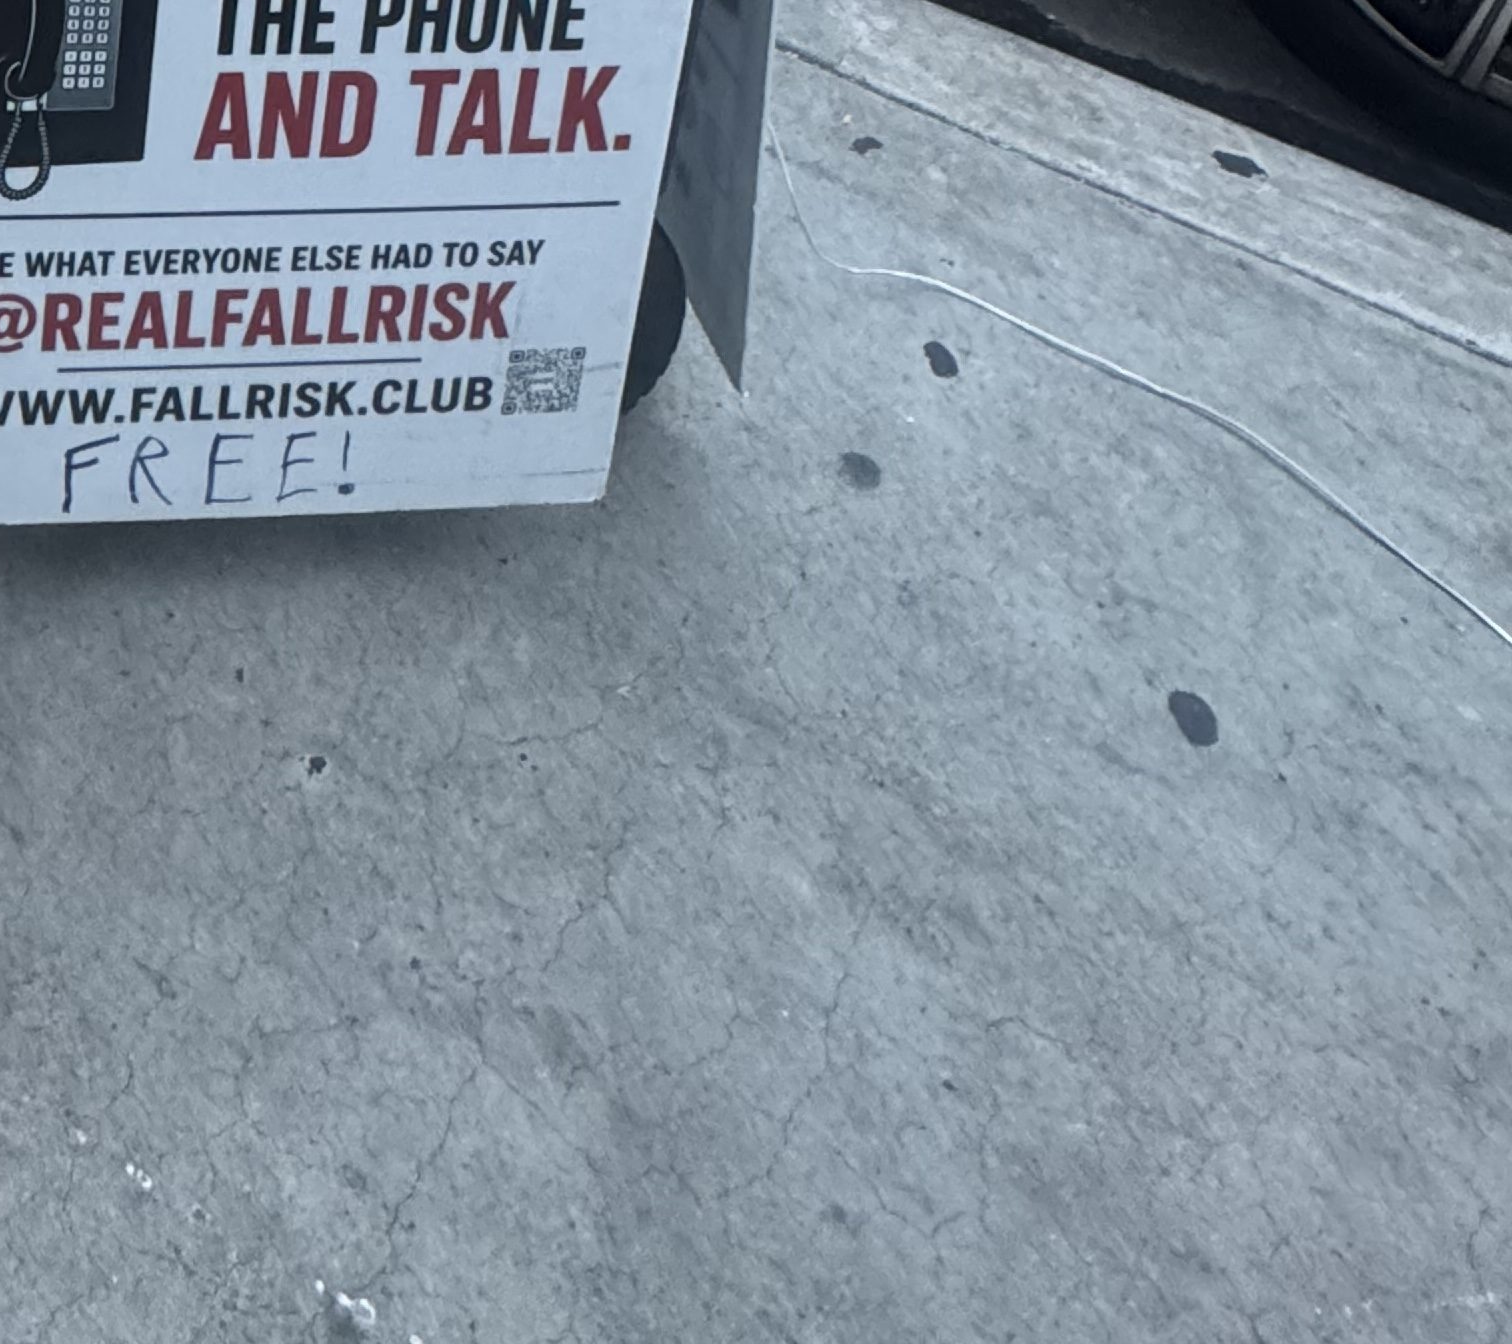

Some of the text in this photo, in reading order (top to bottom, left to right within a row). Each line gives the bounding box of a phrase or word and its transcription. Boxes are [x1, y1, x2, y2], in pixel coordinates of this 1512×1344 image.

[193, 65, 632, 160] AND TALK.
[25, 250, 116, 277] WHAT
[123, 247, 282, 276] EVERYONE
[290, 244, 363, 273] ELSE
[370, 242, 436, 270] HAD
[442, 241, 480, 267] TO
[486, 239, 545, 267] SAY
[62, 430, 355, 513] FREE!
